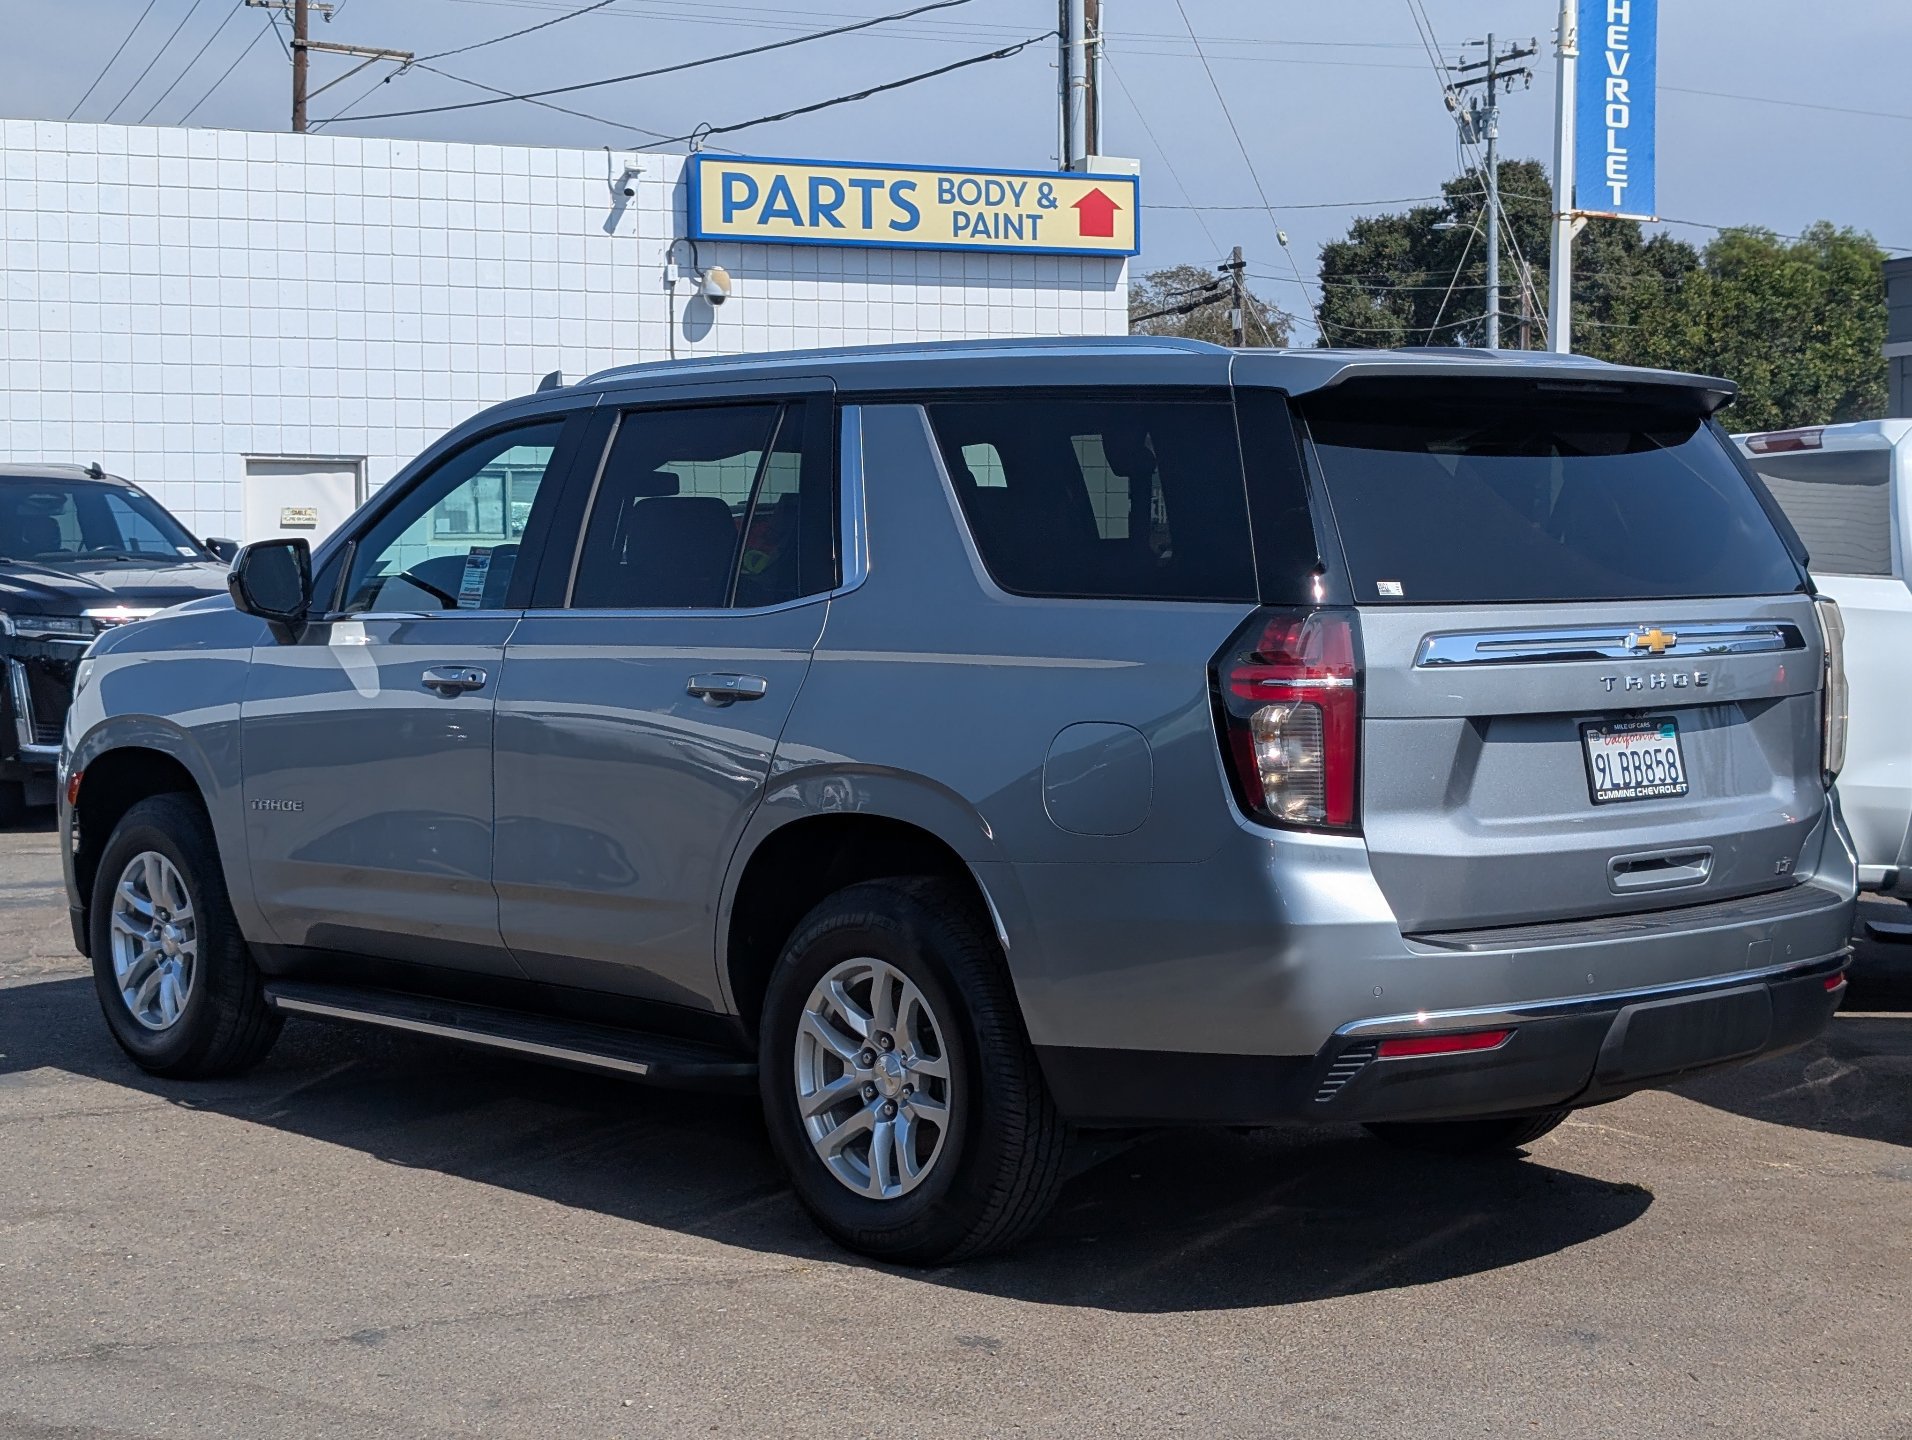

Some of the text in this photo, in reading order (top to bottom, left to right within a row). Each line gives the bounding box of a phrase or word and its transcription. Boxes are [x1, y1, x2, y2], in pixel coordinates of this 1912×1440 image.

[721, 171, 921, 232] PARTS
[937, 177, 1058, 211] BODY &
[952, 211, 1044, 241] PAINT
[1600, 671, 1709, 692] TAHOE
[1636, 721, 1651, 729] CARS
[1602, 732, 1662, 749] California
[1595, 747, 1680, 790] 9LBB858
[1597, 783, 1688, 800] CUMMING CHEVROLET
[250, 798, 305, 812] TAHOE
